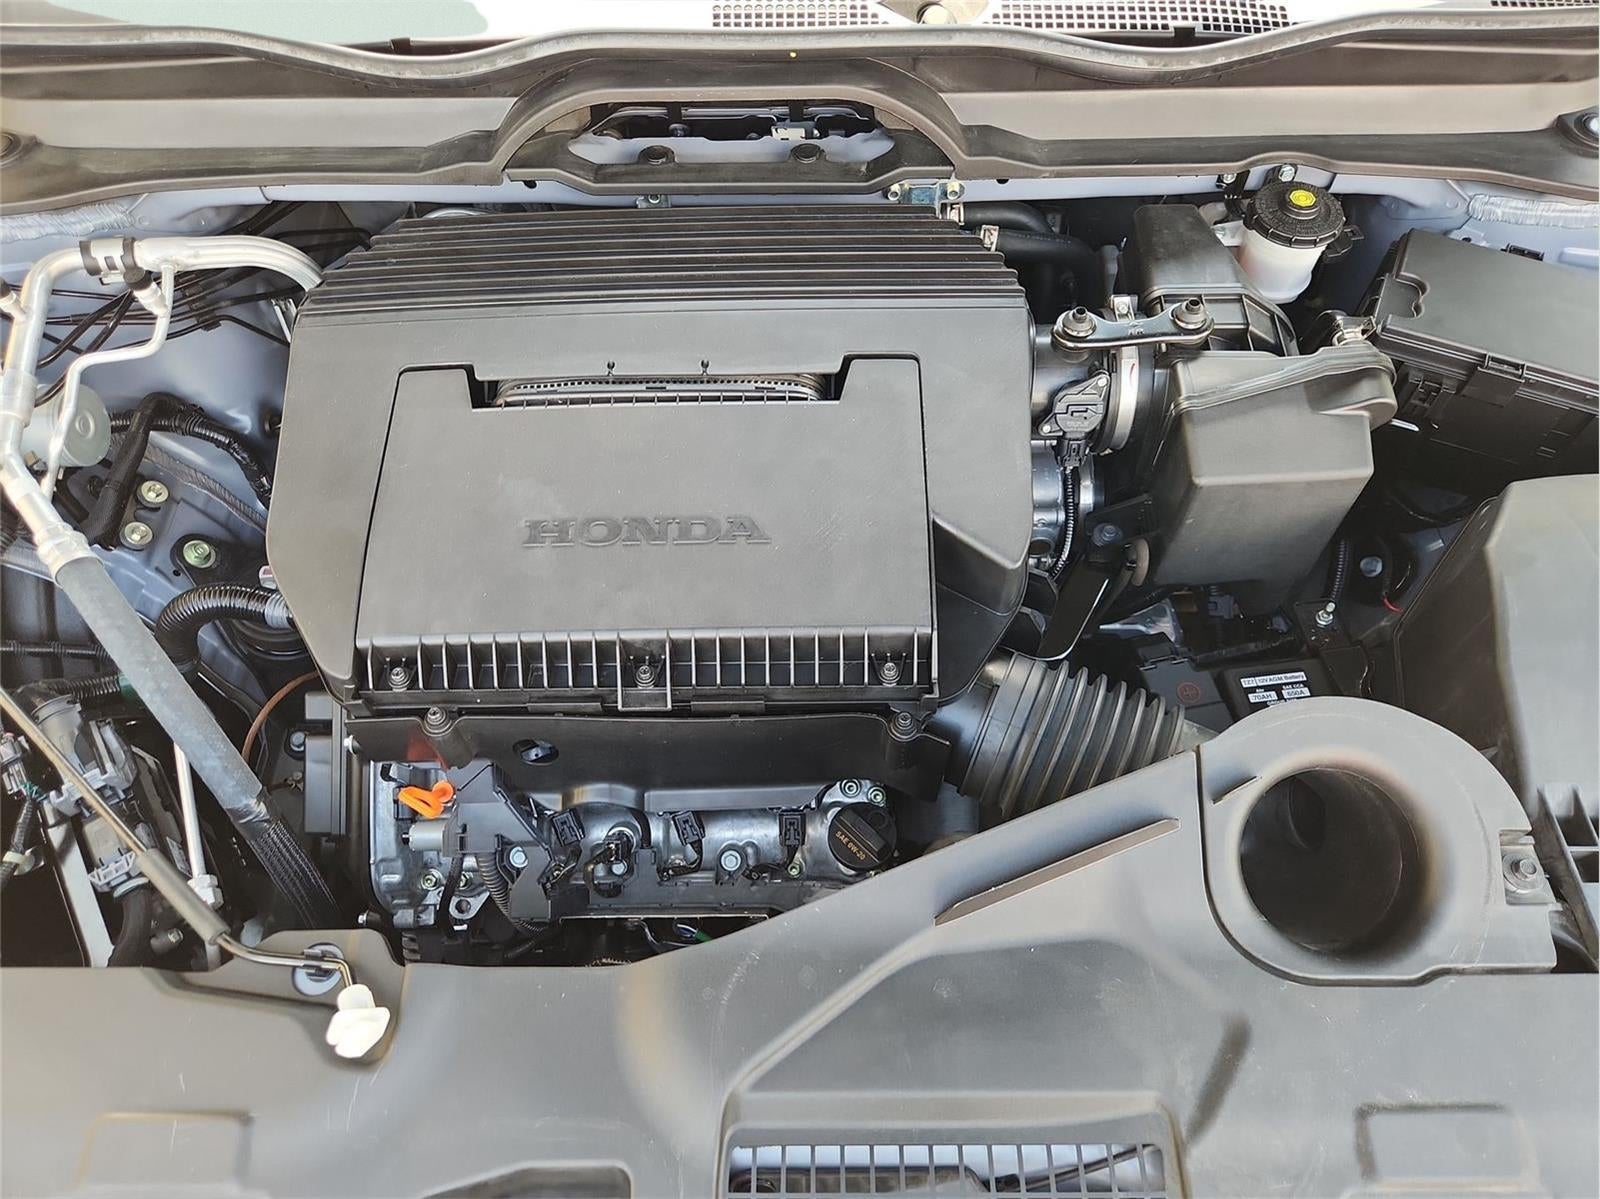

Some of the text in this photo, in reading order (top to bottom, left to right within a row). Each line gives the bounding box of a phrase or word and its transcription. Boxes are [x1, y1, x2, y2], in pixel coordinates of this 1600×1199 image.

[522, 515, 772, 547] HONDA
[835, 831, 866, 860] SAE 0W-20
